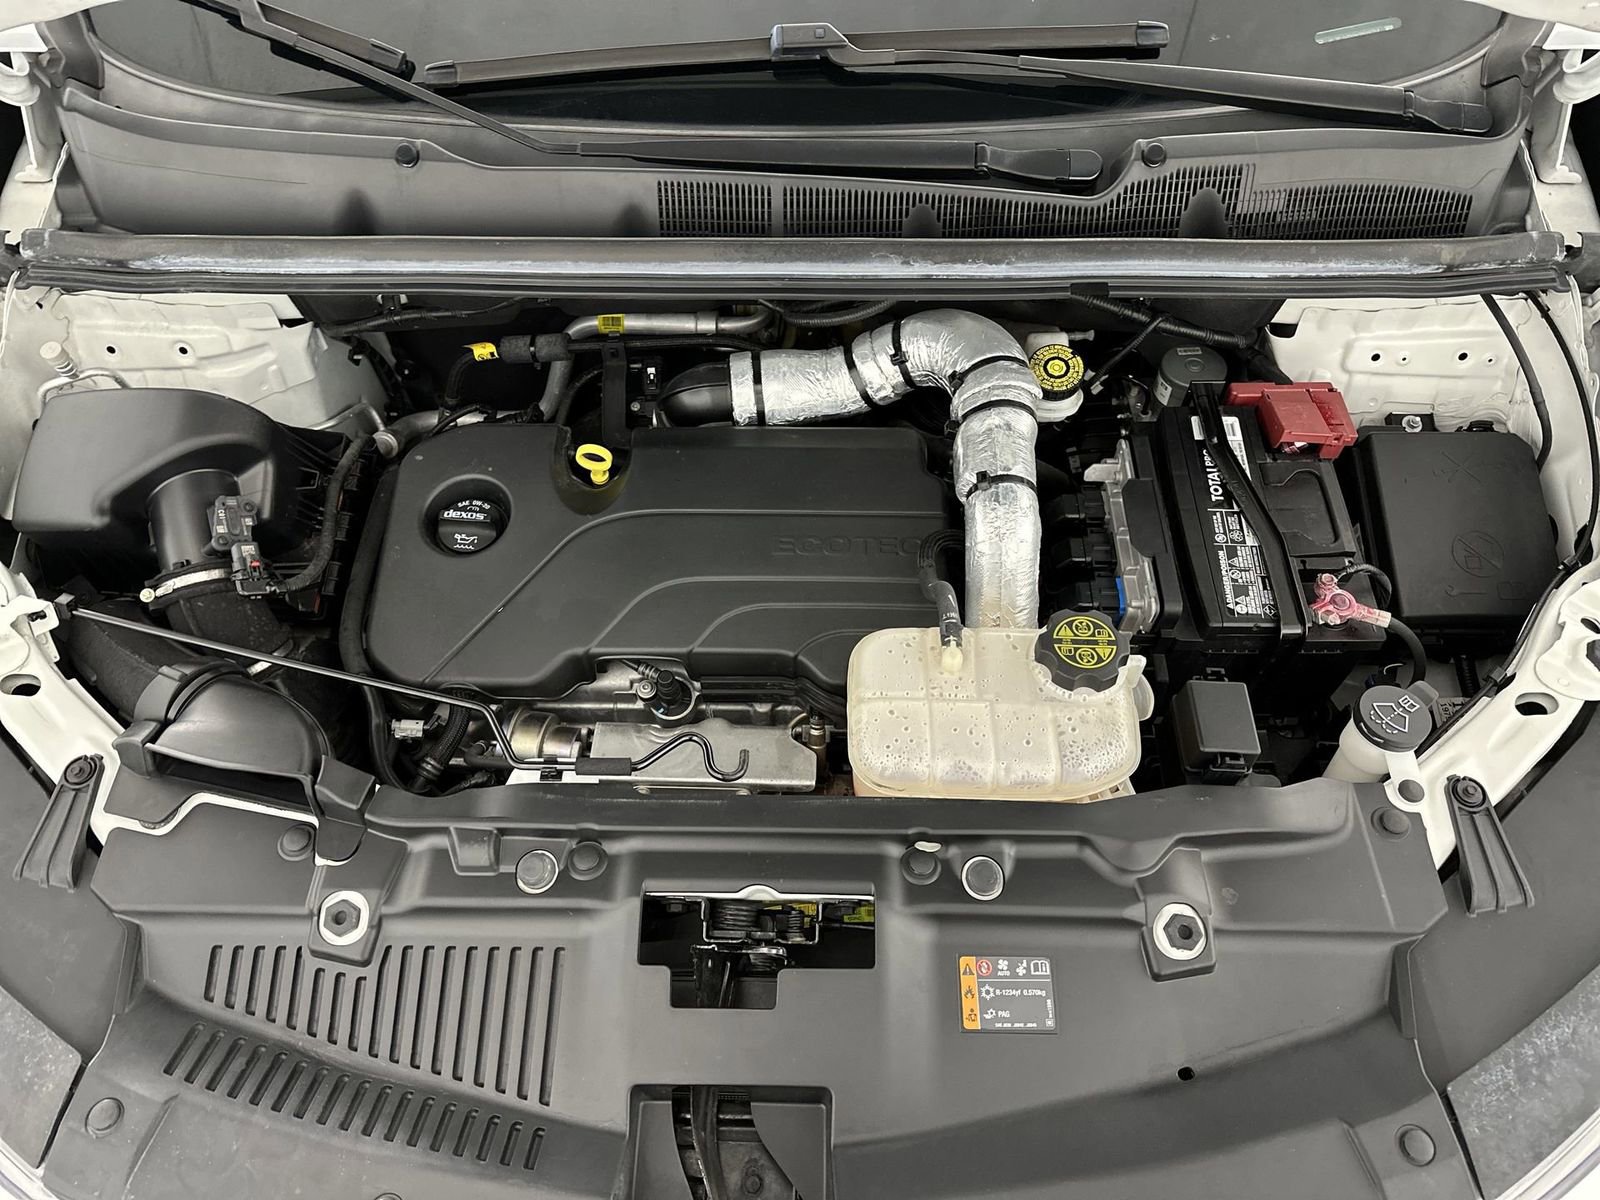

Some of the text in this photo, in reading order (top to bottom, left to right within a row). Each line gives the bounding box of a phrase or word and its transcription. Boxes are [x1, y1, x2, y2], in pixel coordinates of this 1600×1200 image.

[457, 500, 491, 510] SAE 0W-20
[443, 509, 487, 520] dexos
[772, 536, 921, 556] ECOTEC
[995, 989, 1021, 997] R-1234yf
[997, 1010, 1010, 1018] PAG
